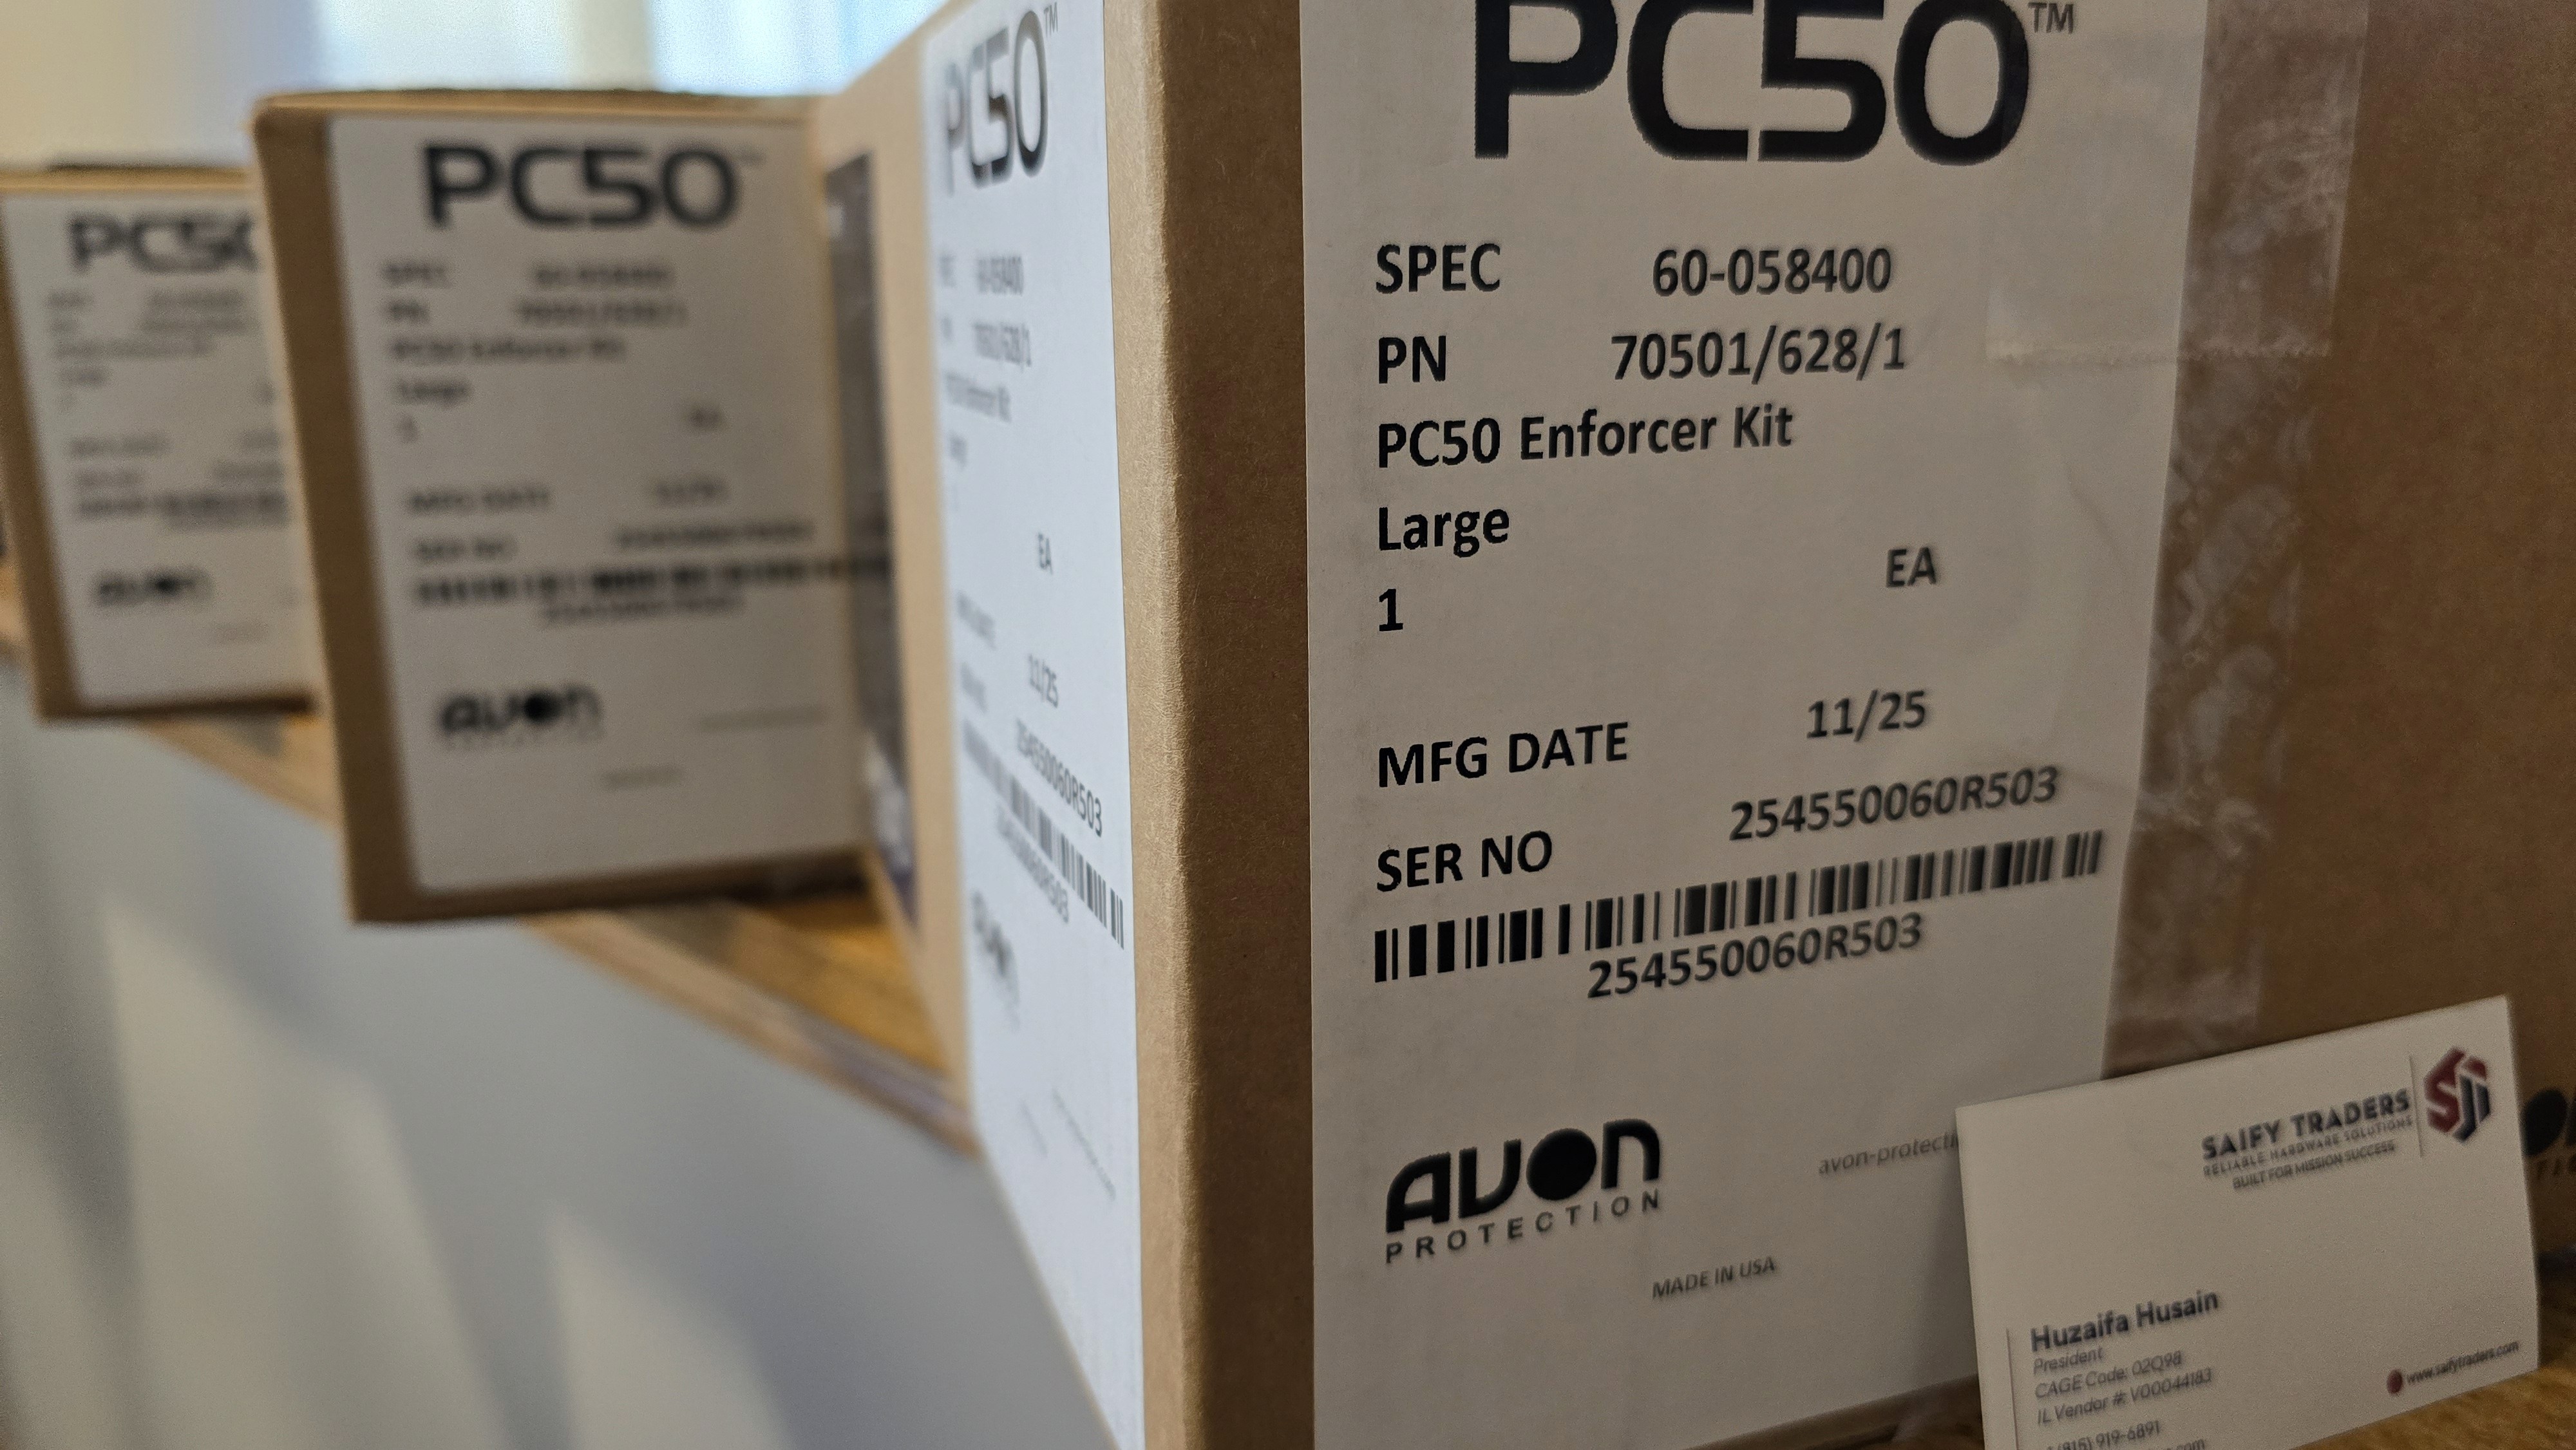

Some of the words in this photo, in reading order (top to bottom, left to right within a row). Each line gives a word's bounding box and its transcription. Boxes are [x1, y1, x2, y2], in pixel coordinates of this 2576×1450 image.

[942, 9, 1050, 197] PC50
[1475, 0, 2031, 166] PC50
[422, 140, 737, 229] PC50
[1376, 242, 1501, 294] SPEC
[1653, 247, 1893, 296] 60-058400
[1378, 335, 1446, 384] PN
[1611, 322, 1906, 384] 70501/628/1
[1378, 417, 1501, 469] PC50
[1520, 408, 1718, 460] Enforcer
[1734, 402, 1794, 448] Kit
[1378, 507, 1510, 558] Large
[1887, 546, 1938, 588] EA
[1379, 588, 1403, 632] 1
[1807, 690, 1927, 742] 11/25
[1378, 736, 1488, 788] MFG
[1509, 722, 1629, 773] DATE
[1729, 765, 2060, 842] 254550060R503
[1376, 843, 1463, 892] SER
[1481, 830, 1553, 878] NO
[1587, 913, 1924, 999] 254550060R503
[2201, 1119, 2281, 1160] SAIFY
[2289, 1089, 2411, 1138] TRADERS
[1385, 1187, 1662, 1265] PROTECTION
[1652, 1272, 1710, 1301] MADE
[1714, 1266, 1736, 1285] IN
[1739, 1256, 1778, 1279] USA
[2031, 1310, 2129, 1352] Huzaifa
[2134, 1289, 2219, 1328] Husain
[2033, 1347, 2104, 1375] President
[2035, 1373, 2083, 1399] CAGE
[2054, 1397, 2110, 1420] Vendor
